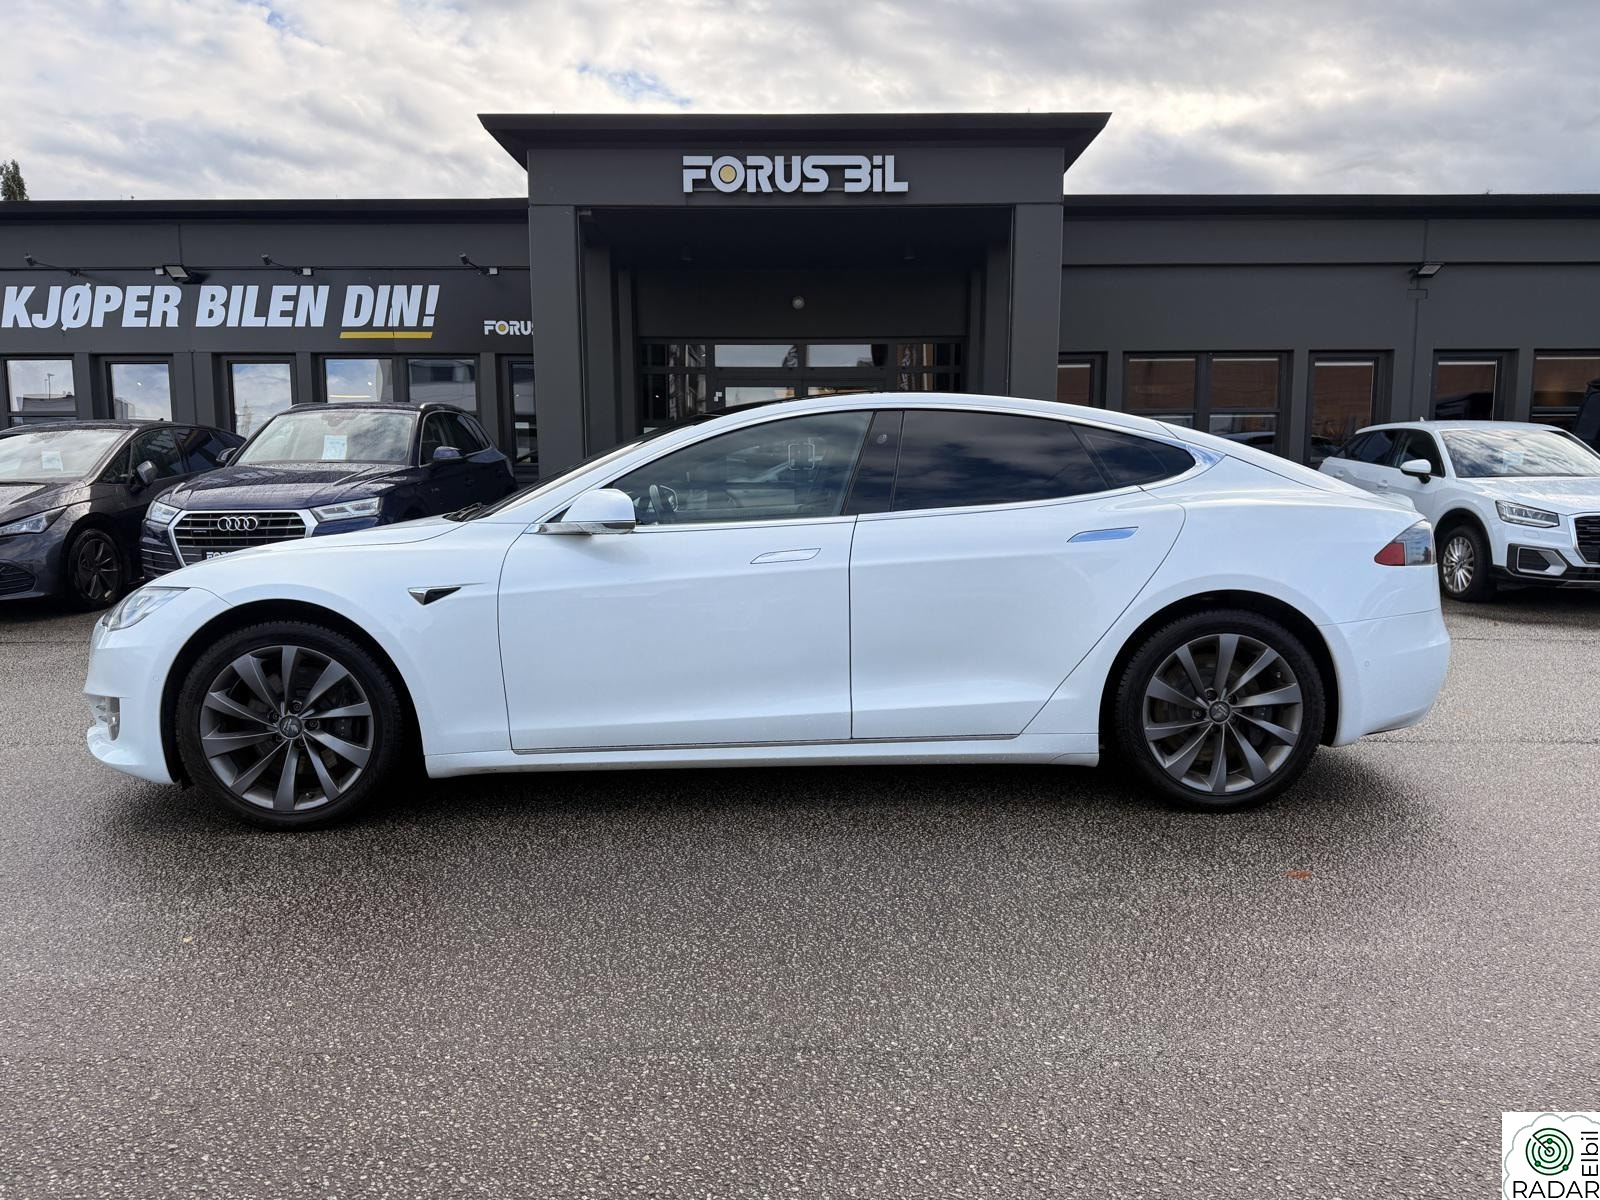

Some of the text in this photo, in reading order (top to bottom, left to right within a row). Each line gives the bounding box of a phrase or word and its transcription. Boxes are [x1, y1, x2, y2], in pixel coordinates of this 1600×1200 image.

[683, 155, 829, 192] FORUS
[1, 282, 440, 331] KJØPER BILEN DIN!
[484, 320, 534, 335] FORU
